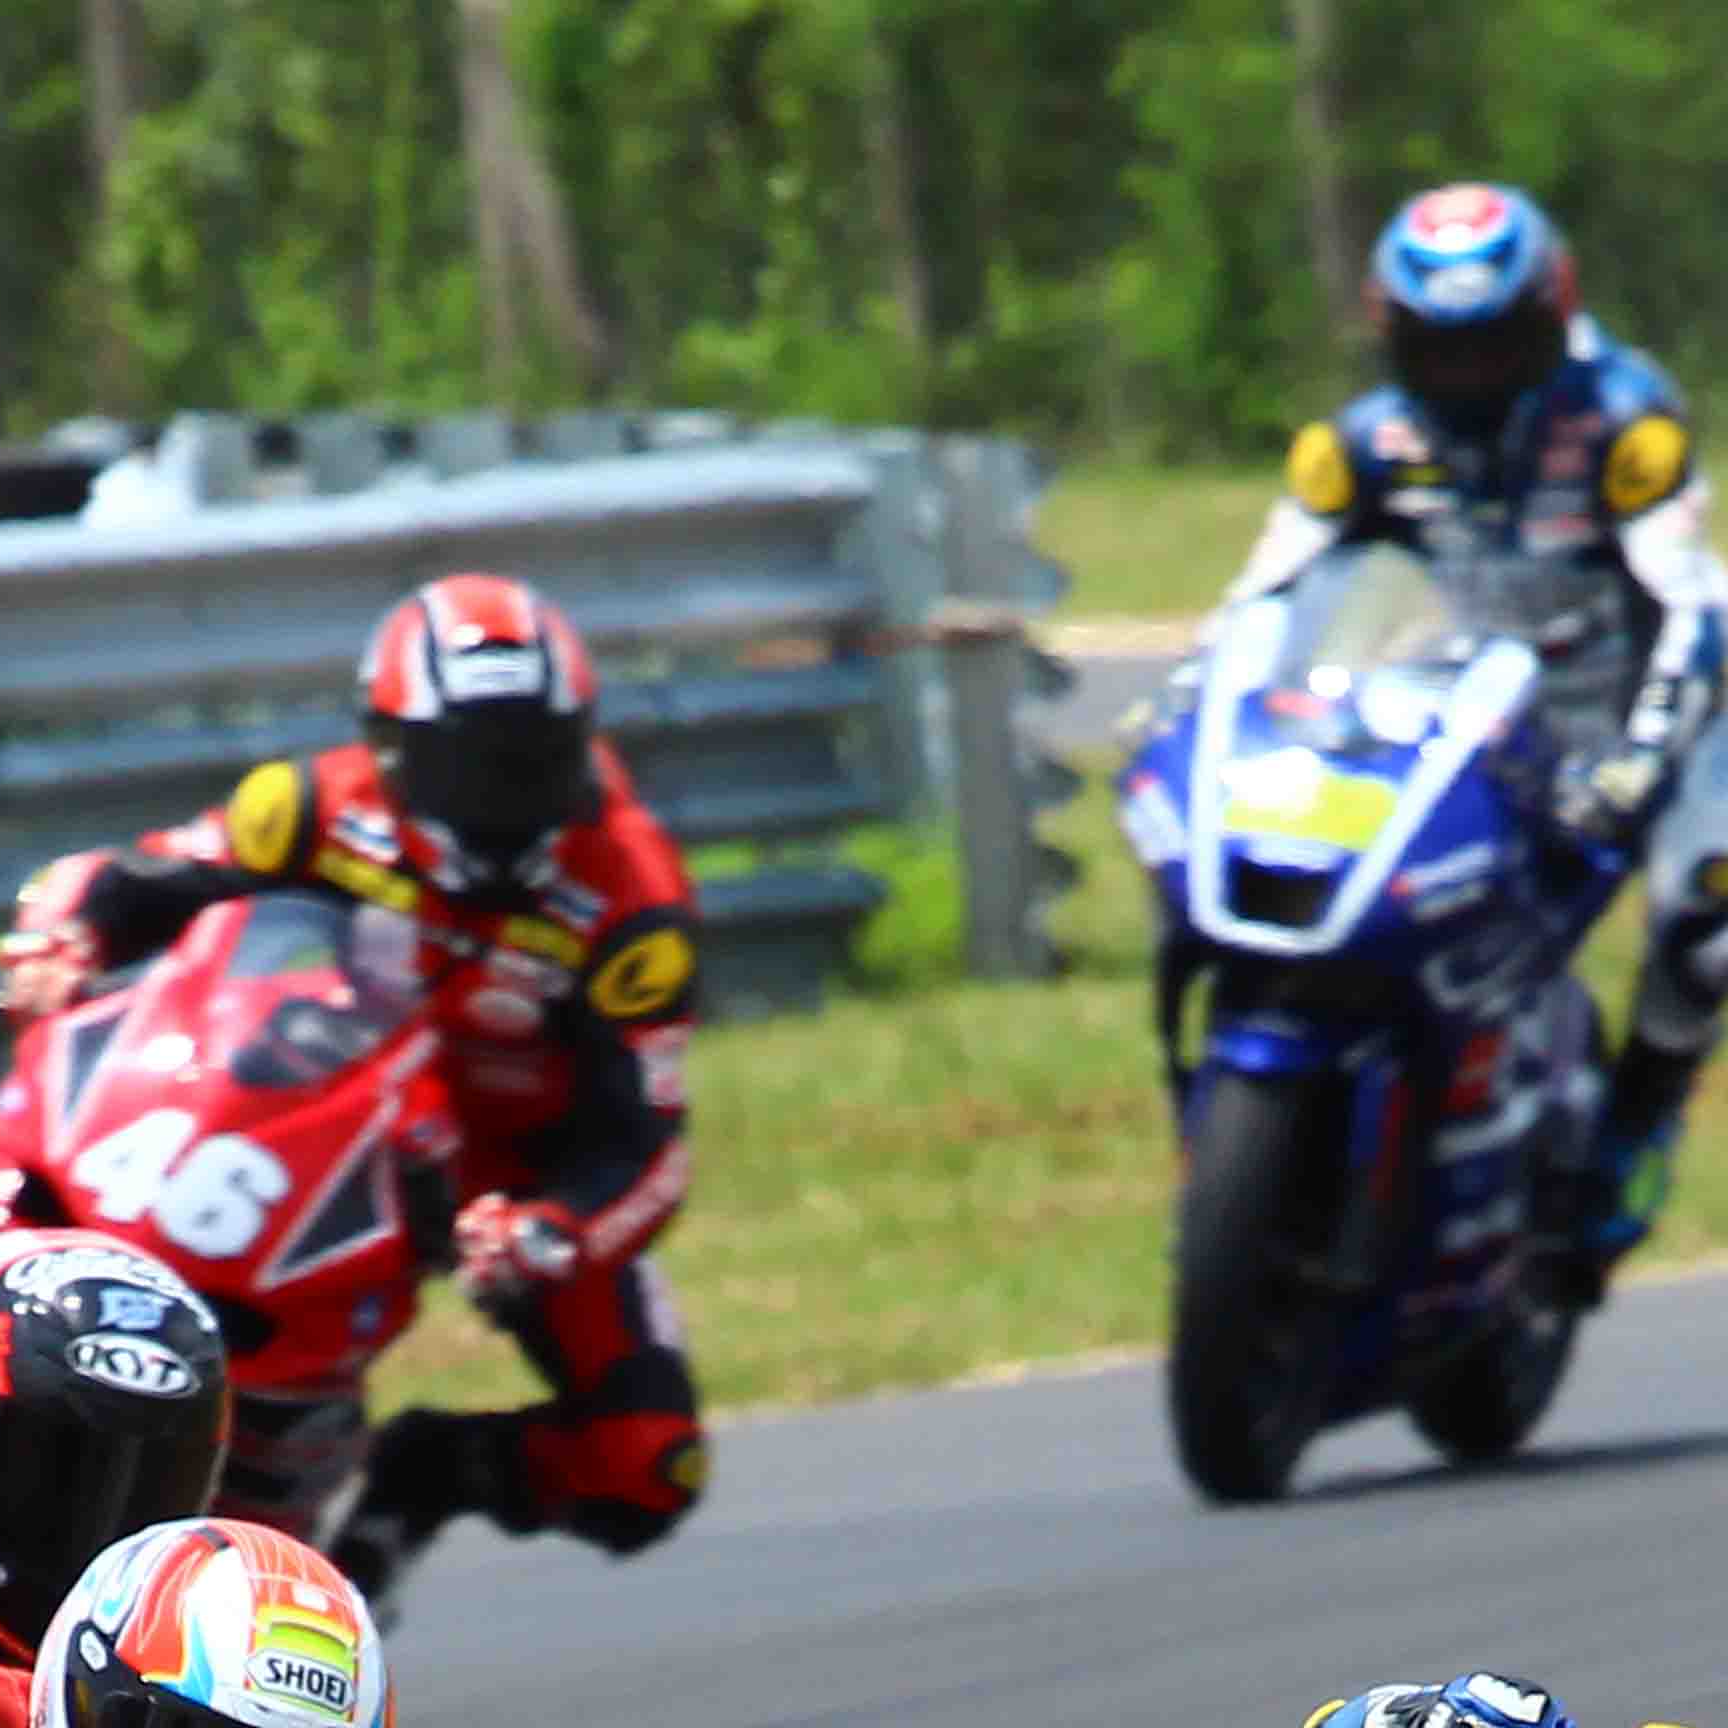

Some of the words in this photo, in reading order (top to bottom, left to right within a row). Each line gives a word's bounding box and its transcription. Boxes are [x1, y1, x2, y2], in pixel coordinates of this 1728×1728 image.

[70, 1109, 293, 1260] 46
[74, 1342, 181, 1388] KYT
[265, 1657, 348, 1705] SHOEI
